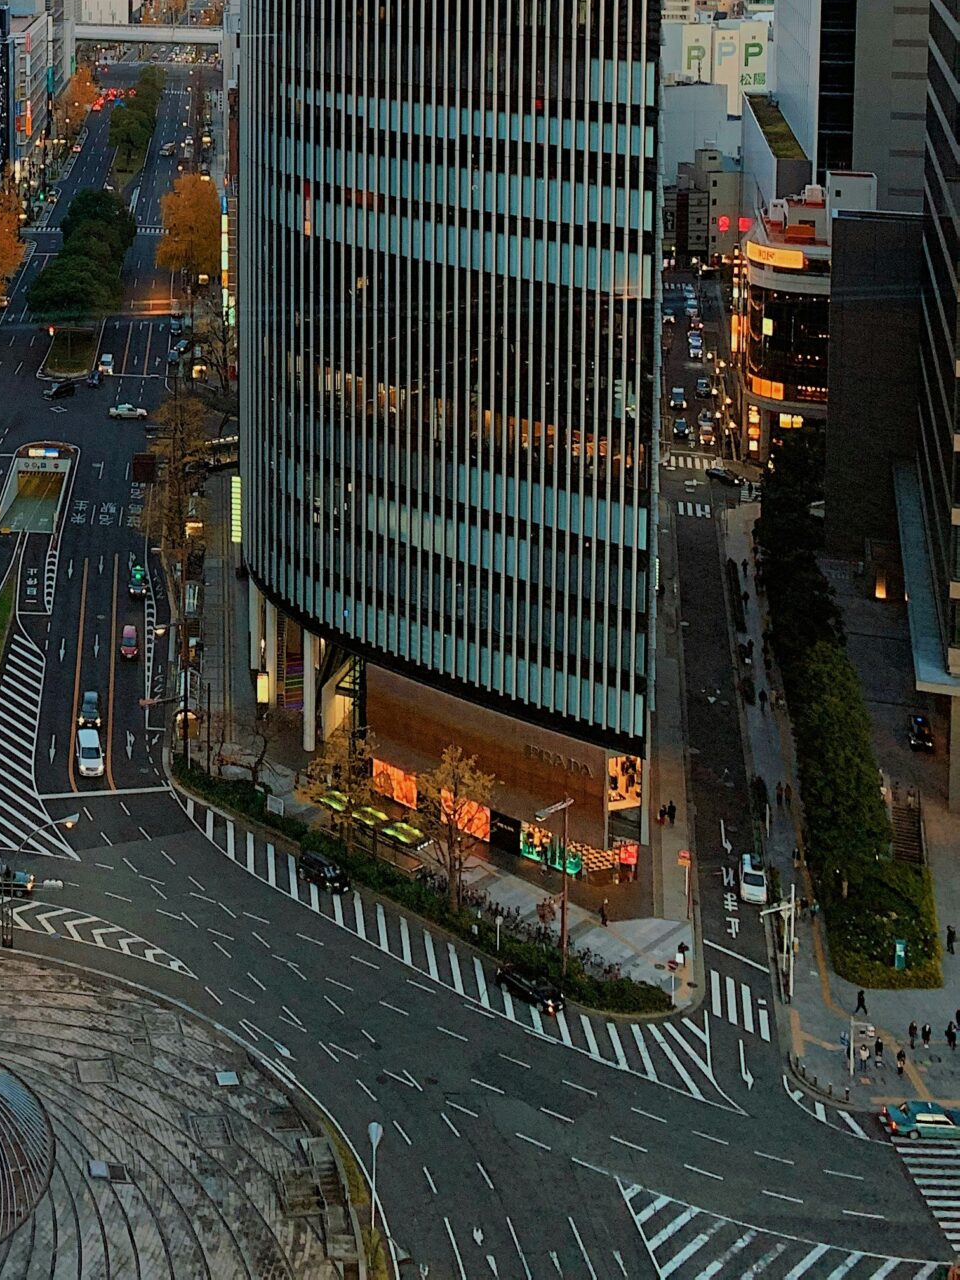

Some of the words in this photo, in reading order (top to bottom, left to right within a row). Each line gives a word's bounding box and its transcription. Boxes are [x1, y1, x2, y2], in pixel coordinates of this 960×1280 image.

[687, 45, 706, 70] P
[717, 42, 737, 66] P
[744, 42, 763, 67] P
[740, 72, 766, 86] 松陽
[526, 743, 594, 780] PRADA
[720, 865, 740, 939] 止まれ
